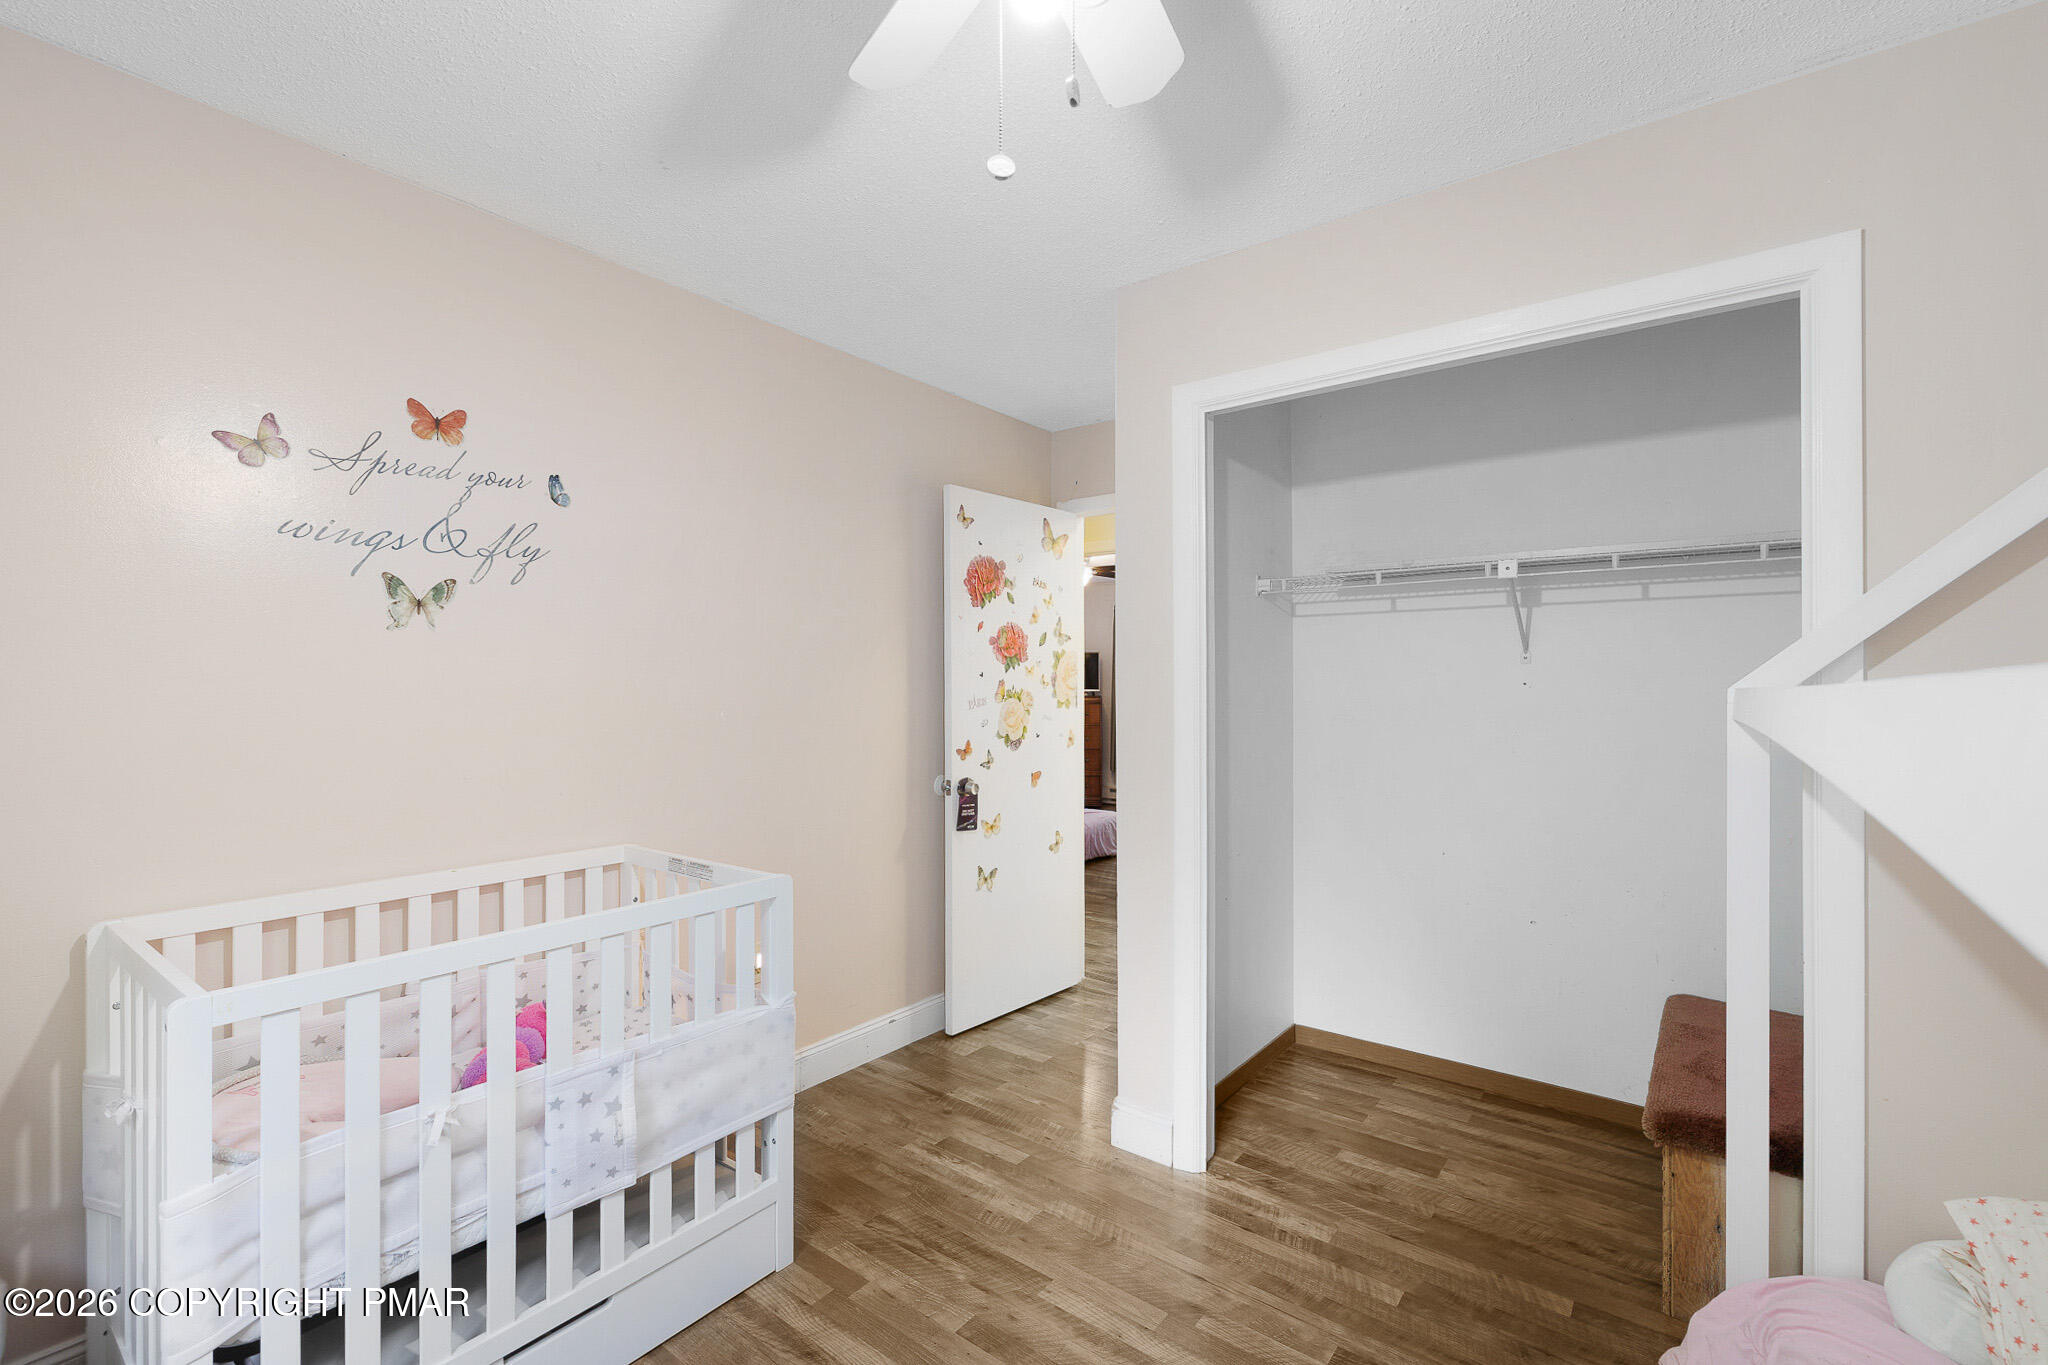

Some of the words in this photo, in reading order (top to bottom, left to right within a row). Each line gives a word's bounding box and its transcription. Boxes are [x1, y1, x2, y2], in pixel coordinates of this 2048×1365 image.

[308, 431, 467, 495] Spread
[459, 471, 532, 502] your
[277, 519, 418, 576] wings
[423, 502, 477, 557] &
[471, 522, 552, 585] fly
